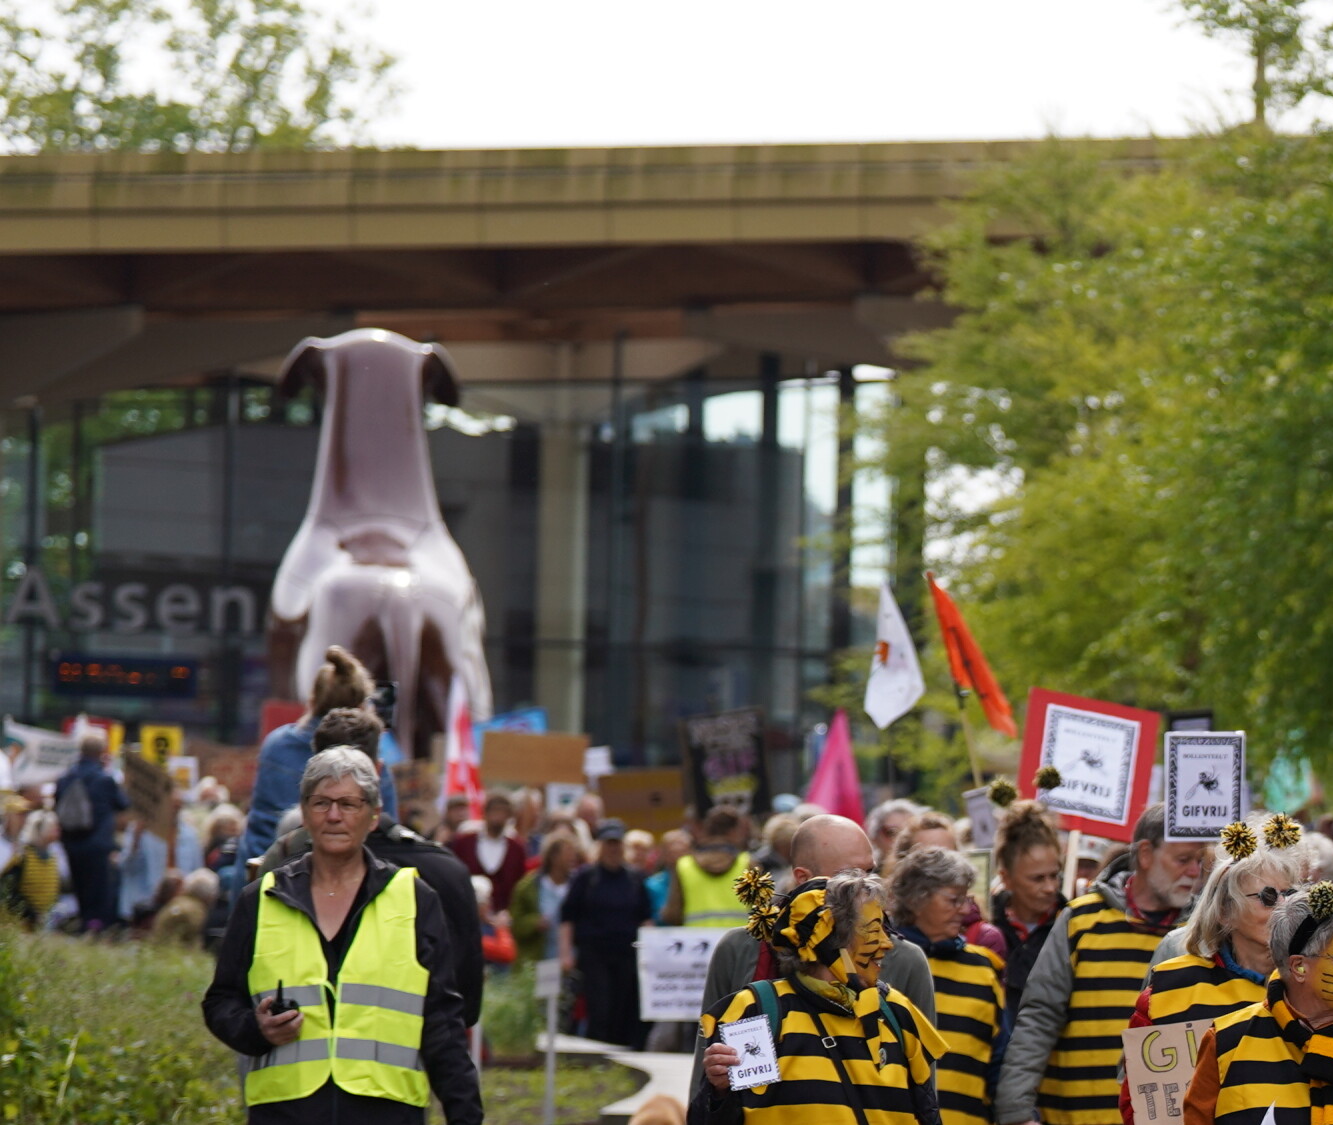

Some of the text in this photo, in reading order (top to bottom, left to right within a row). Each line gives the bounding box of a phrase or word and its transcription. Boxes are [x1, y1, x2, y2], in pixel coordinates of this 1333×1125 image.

[7, 563, 256, 634] Assen
[1182, 804, 1227, 818] GIFVRIJ
[737, 1063, 773, 1079] GIFVRIJ
